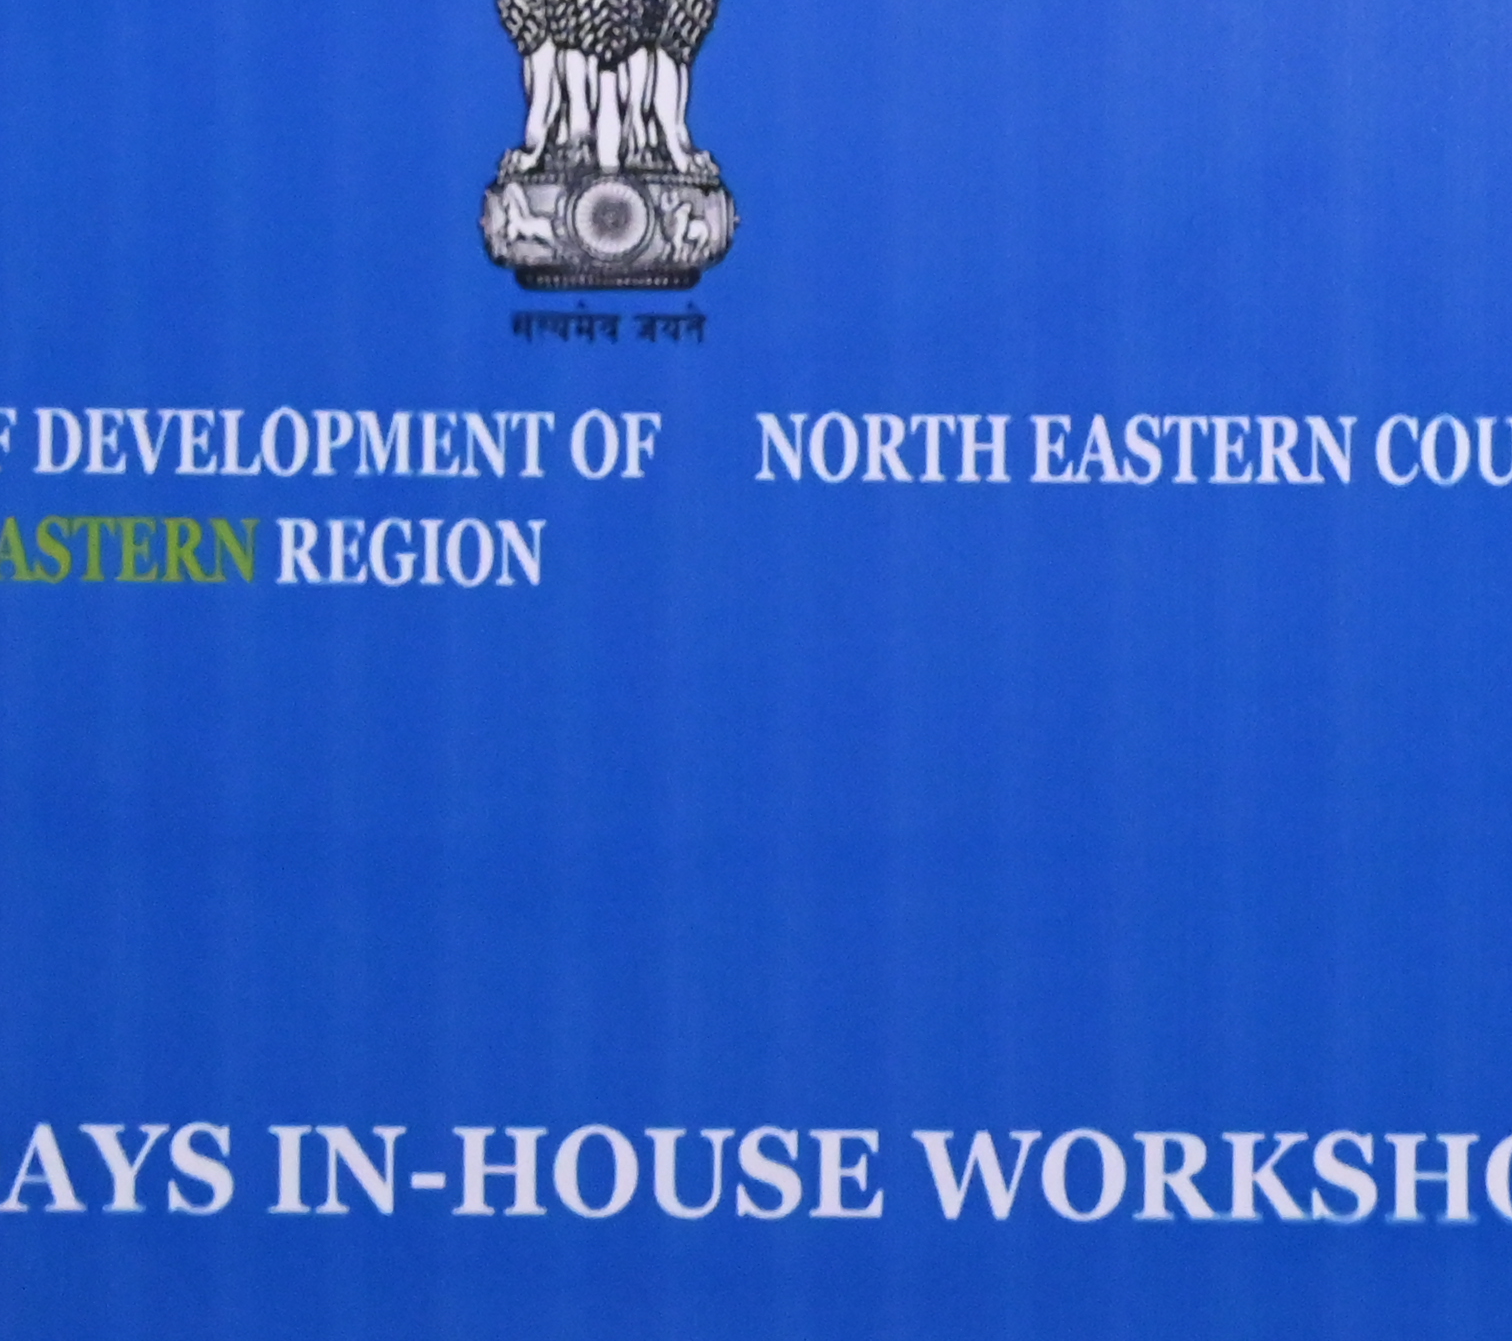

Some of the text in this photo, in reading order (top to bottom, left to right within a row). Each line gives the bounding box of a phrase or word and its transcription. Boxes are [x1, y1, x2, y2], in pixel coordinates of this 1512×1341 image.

[34, 405, 556, 478] DEVELOPMENT
[569, 408, 662, 480] OF
[754, 410, 1011, 484] NORTH
[1030, 413, 1358, 486] EASTERN
[276, 517, 547, 588] REGION
[269, 1124, 885, 1220] IN-HOUSE
